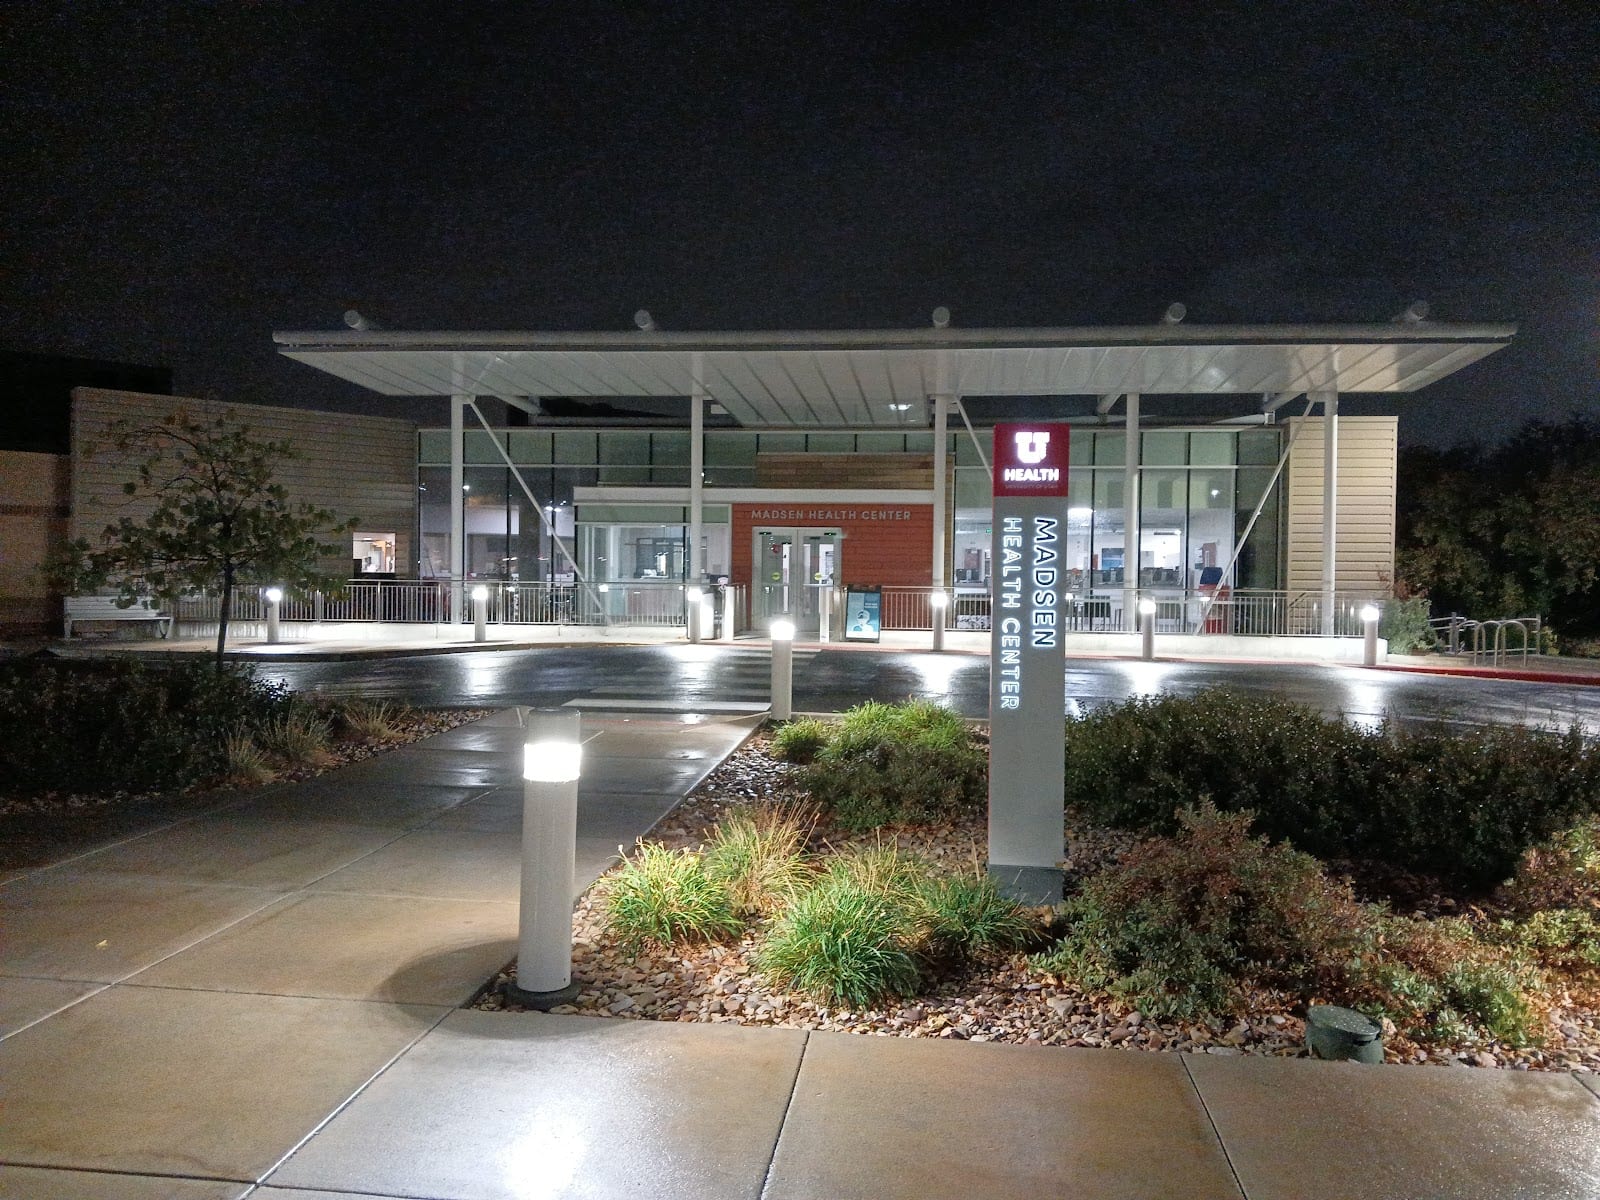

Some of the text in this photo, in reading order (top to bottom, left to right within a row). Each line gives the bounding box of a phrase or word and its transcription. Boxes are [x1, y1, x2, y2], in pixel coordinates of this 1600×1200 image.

[1015, 431, 1050, 464] U
[1004, 468, 1060, 481] HEALTH
[751, 510, 912, 520] MADSEN HEALTH CENTER
[1033, 517, 1057, 648] MADSEN
[1001, 516, 1022, 710] HEALTH CENTER
